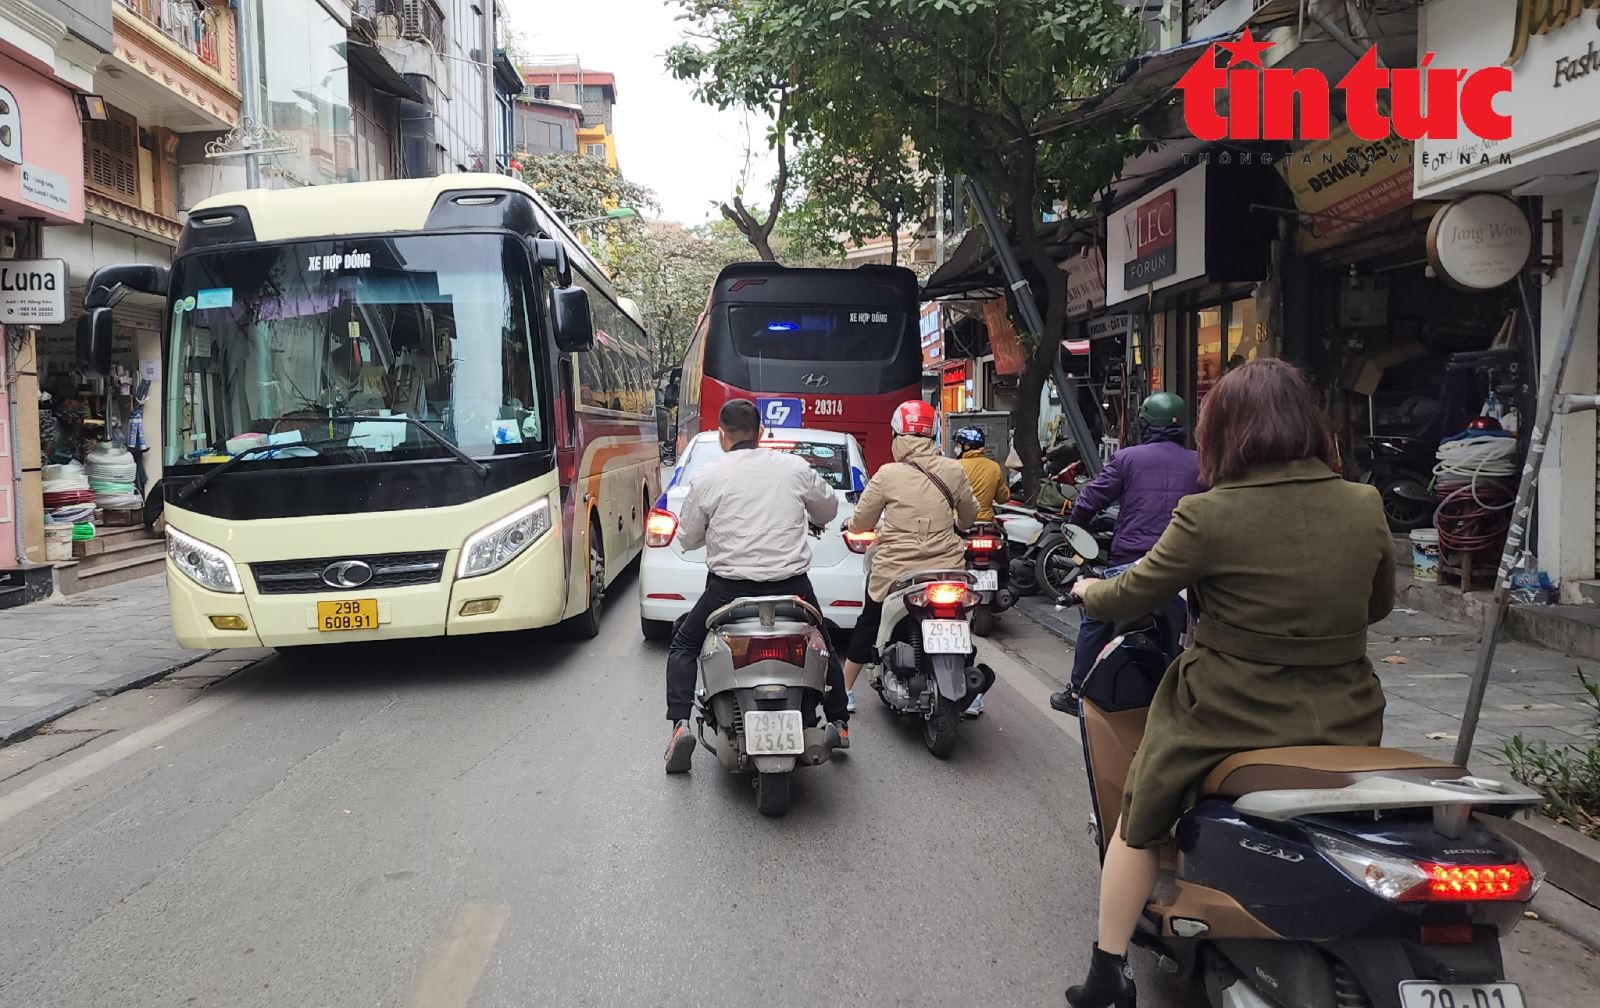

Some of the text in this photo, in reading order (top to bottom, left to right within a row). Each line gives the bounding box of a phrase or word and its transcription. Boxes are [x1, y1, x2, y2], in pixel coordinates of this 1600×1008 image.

[1451, 222, 1523, 245] Jang Won
[308, 256, 320, 271] XE
[323, 253, 342, 272] HỢP
[1130, 253, 1166, 279] FORUM
[1, 268, 56, 291] Luna
[850, 313, 857, 322] XE
[859, 313, 870, 324] HỢP
[766, 401, 791, 425] G7
[814, 399, 843, 416] 20314
[335, 602, 360, 614] 29B
[325, 615, 370, 629] 608.91
[930, 623, 962, 636] 29-C1
[754, 733, 795, 751] 2545
